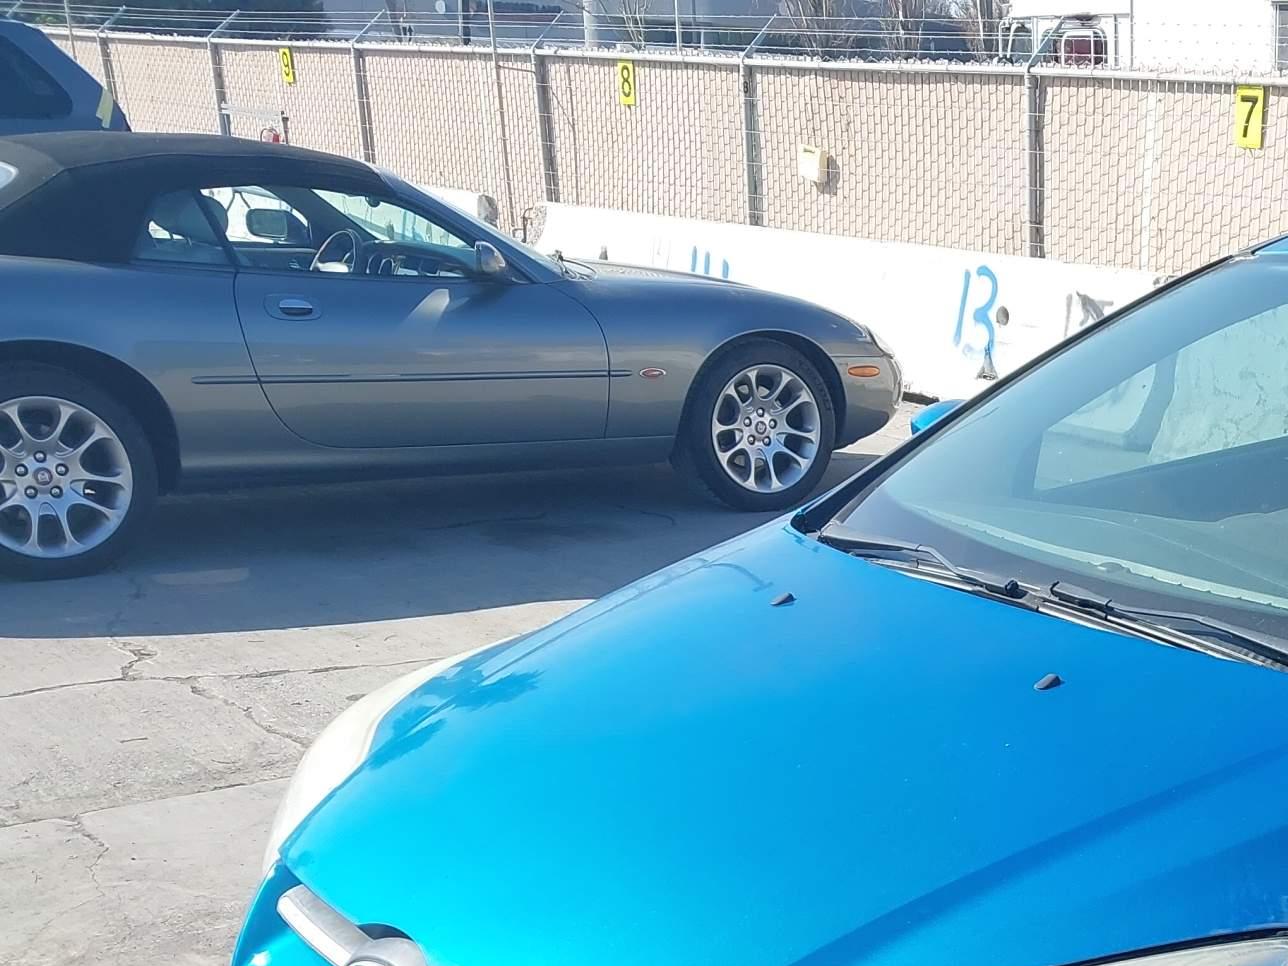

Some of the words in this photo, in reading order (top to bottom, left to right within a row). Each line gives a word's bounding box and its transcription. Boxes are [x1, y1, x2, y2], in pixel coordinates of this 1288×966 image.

[282, 51, 290, 77] 9
[621, 65, 632, 97] 8
[1240, 95, 1259, 138] 7
